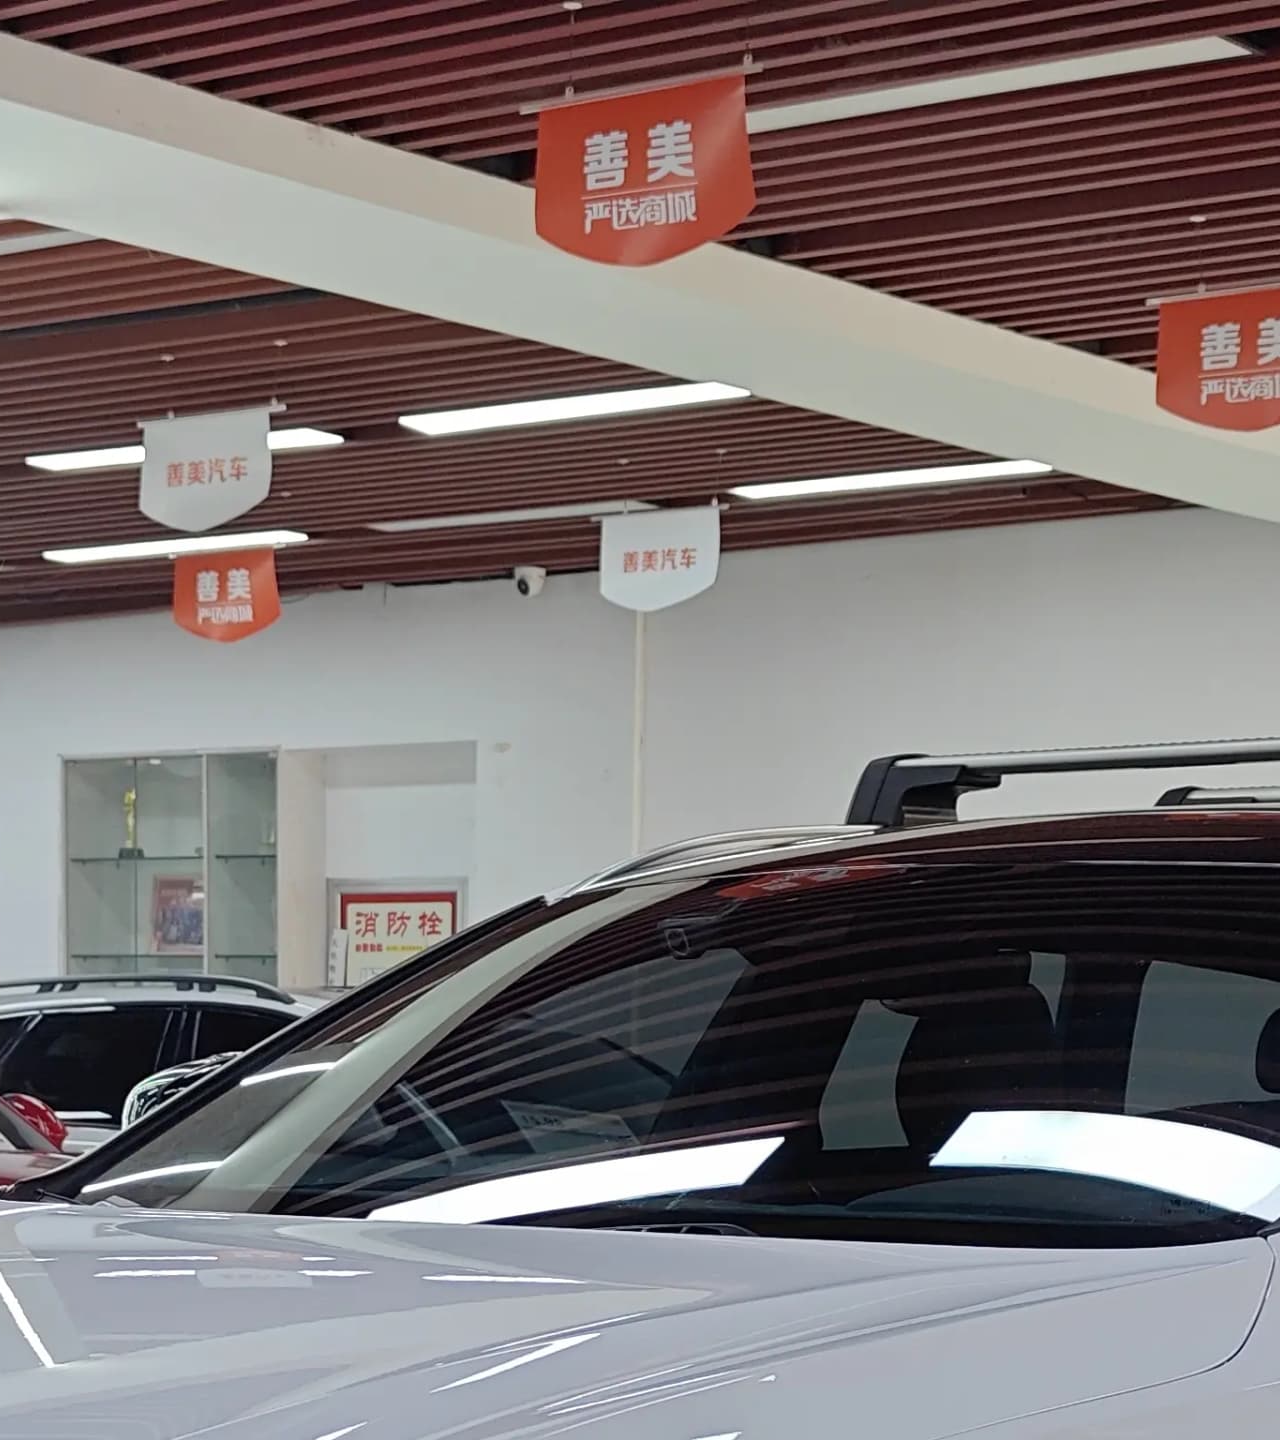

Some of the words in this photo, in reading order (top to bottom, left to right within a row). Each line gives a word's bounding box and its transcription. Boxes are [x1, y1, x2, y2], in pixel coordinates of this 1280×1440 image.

[584, 120, 695, 191] 善美
[584, 191, 698, 234] 严选商城
[167, 456, 248, 487] 善美汽车
[623, 547, 697, 573] 善美汽车
[196, 567, 253, 602] 善美
[355, 911, 443, 938] 消防栓
